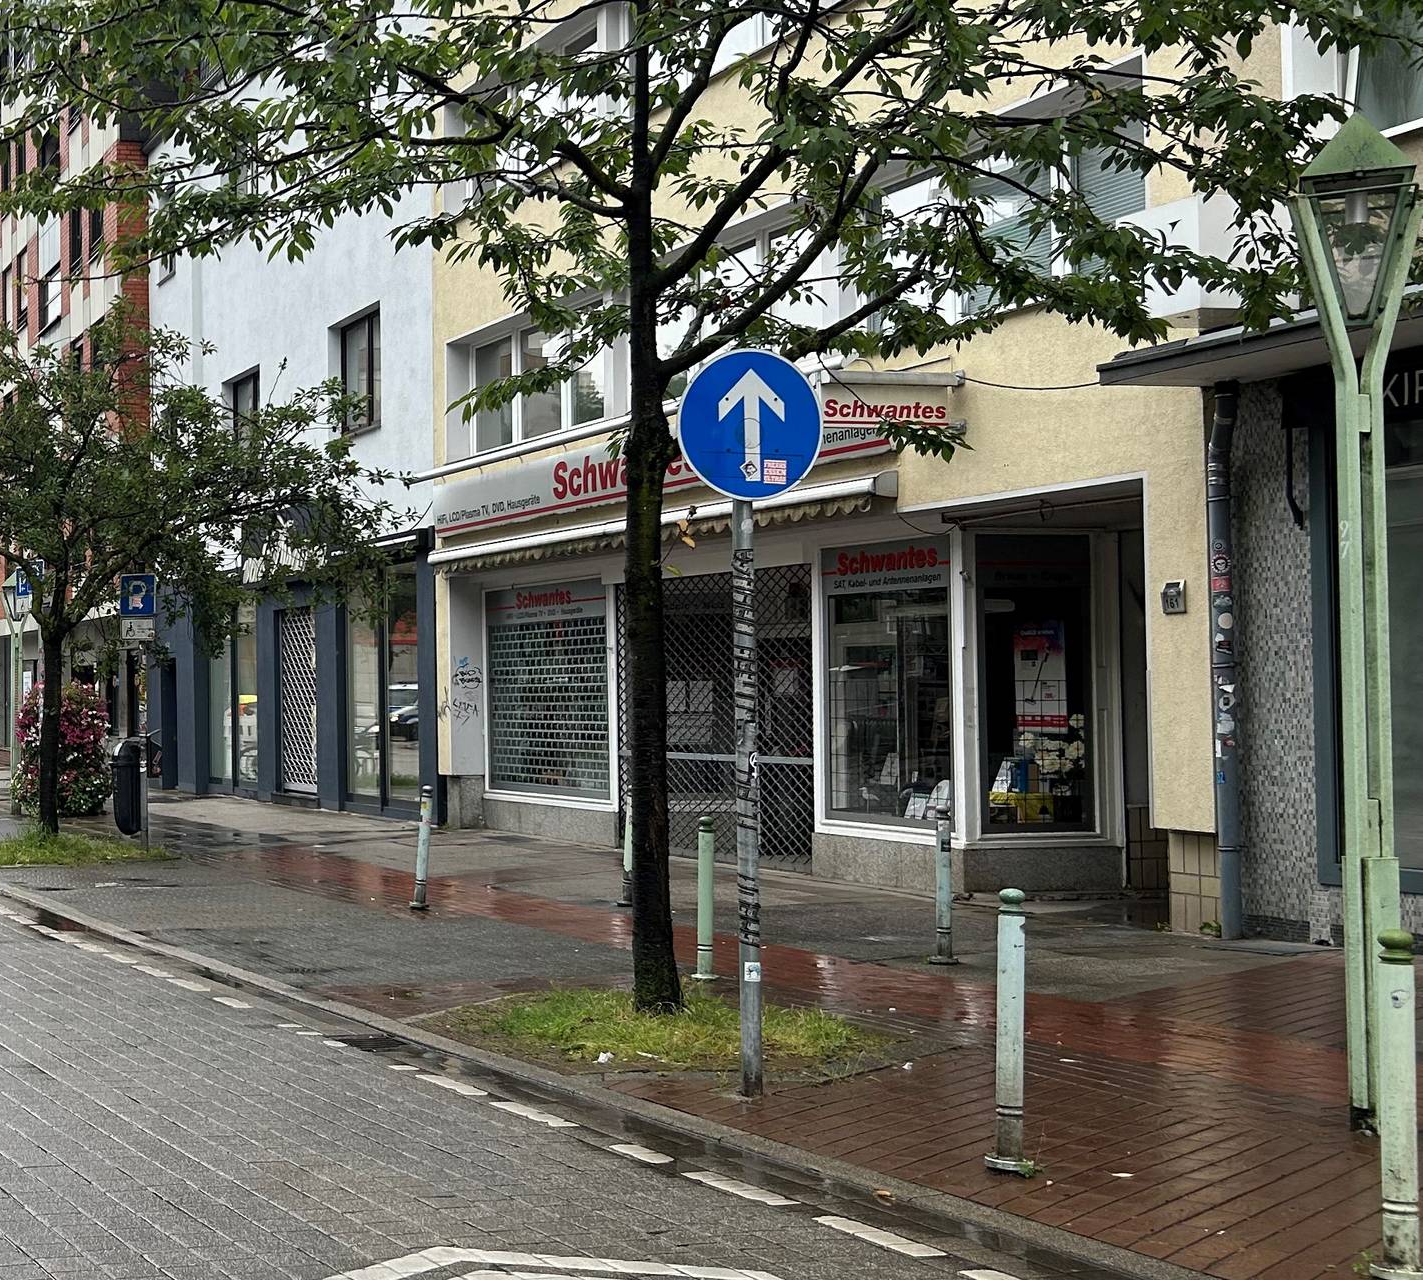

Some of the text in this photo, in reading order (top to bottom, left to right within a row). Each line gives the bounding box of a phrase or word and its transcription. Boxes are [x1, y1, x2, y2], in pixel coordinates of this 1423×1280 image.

[824, 399, 947, 420] Schwantes
[837, 545, 938, 577] Schwantes
[883, 573, 942, 585] Antennenanlagen
[516, 589, 572, 610] Schwantes
[1166, 598, 1179, 609] 161
